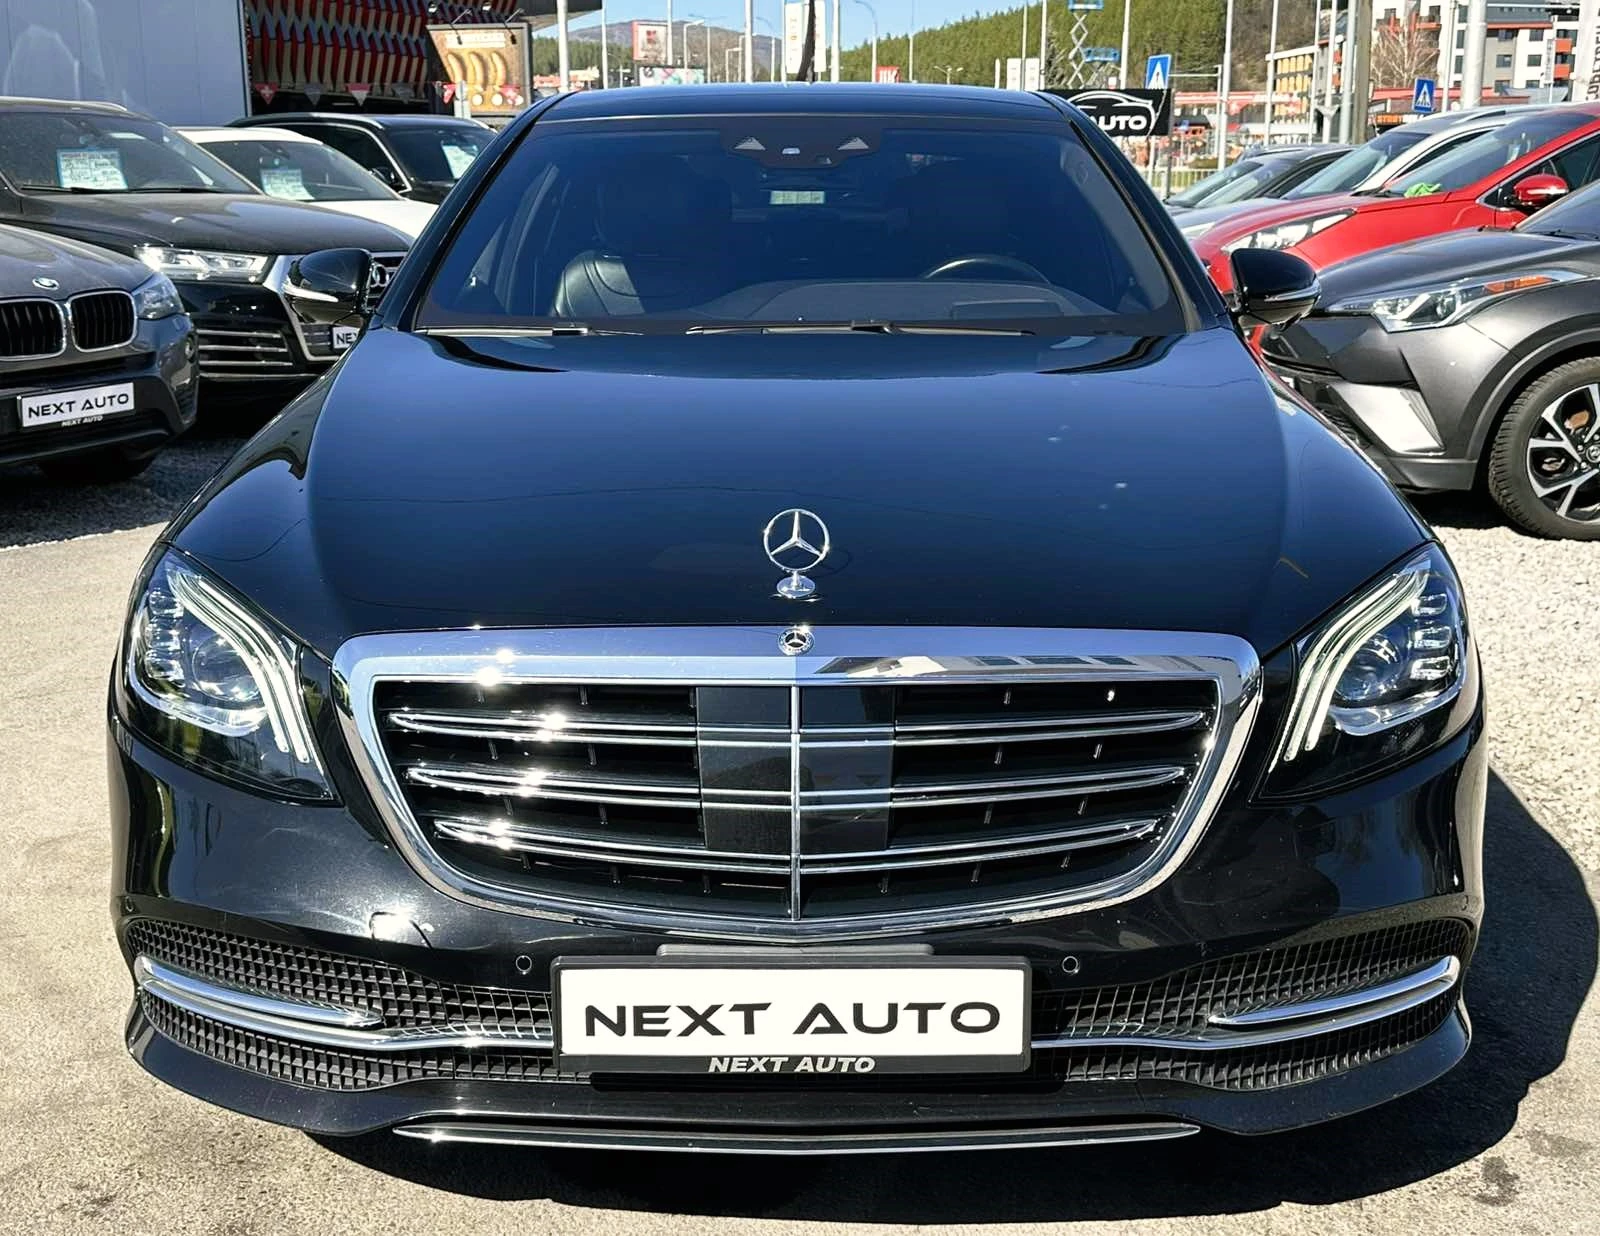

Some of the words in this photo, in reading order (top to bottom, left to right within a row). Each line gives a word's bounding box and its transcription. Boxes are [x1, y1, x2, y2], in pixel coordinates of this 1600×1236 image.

[336, 333, 357, 345] NE
[28, 401, 77, 418] NEXT
[81, 393, 129, 411] AUTO
[61, 418, 82, 427] NEXT
[82, 416, 103, 424] AUTO
[585, 1002, 772, 1037] NEXT
[793, 1001, 1001, 1035] AUTO
[708, 1056, 788, 1074] NEXT
[794, 1056, 876, 1074] AUTO
